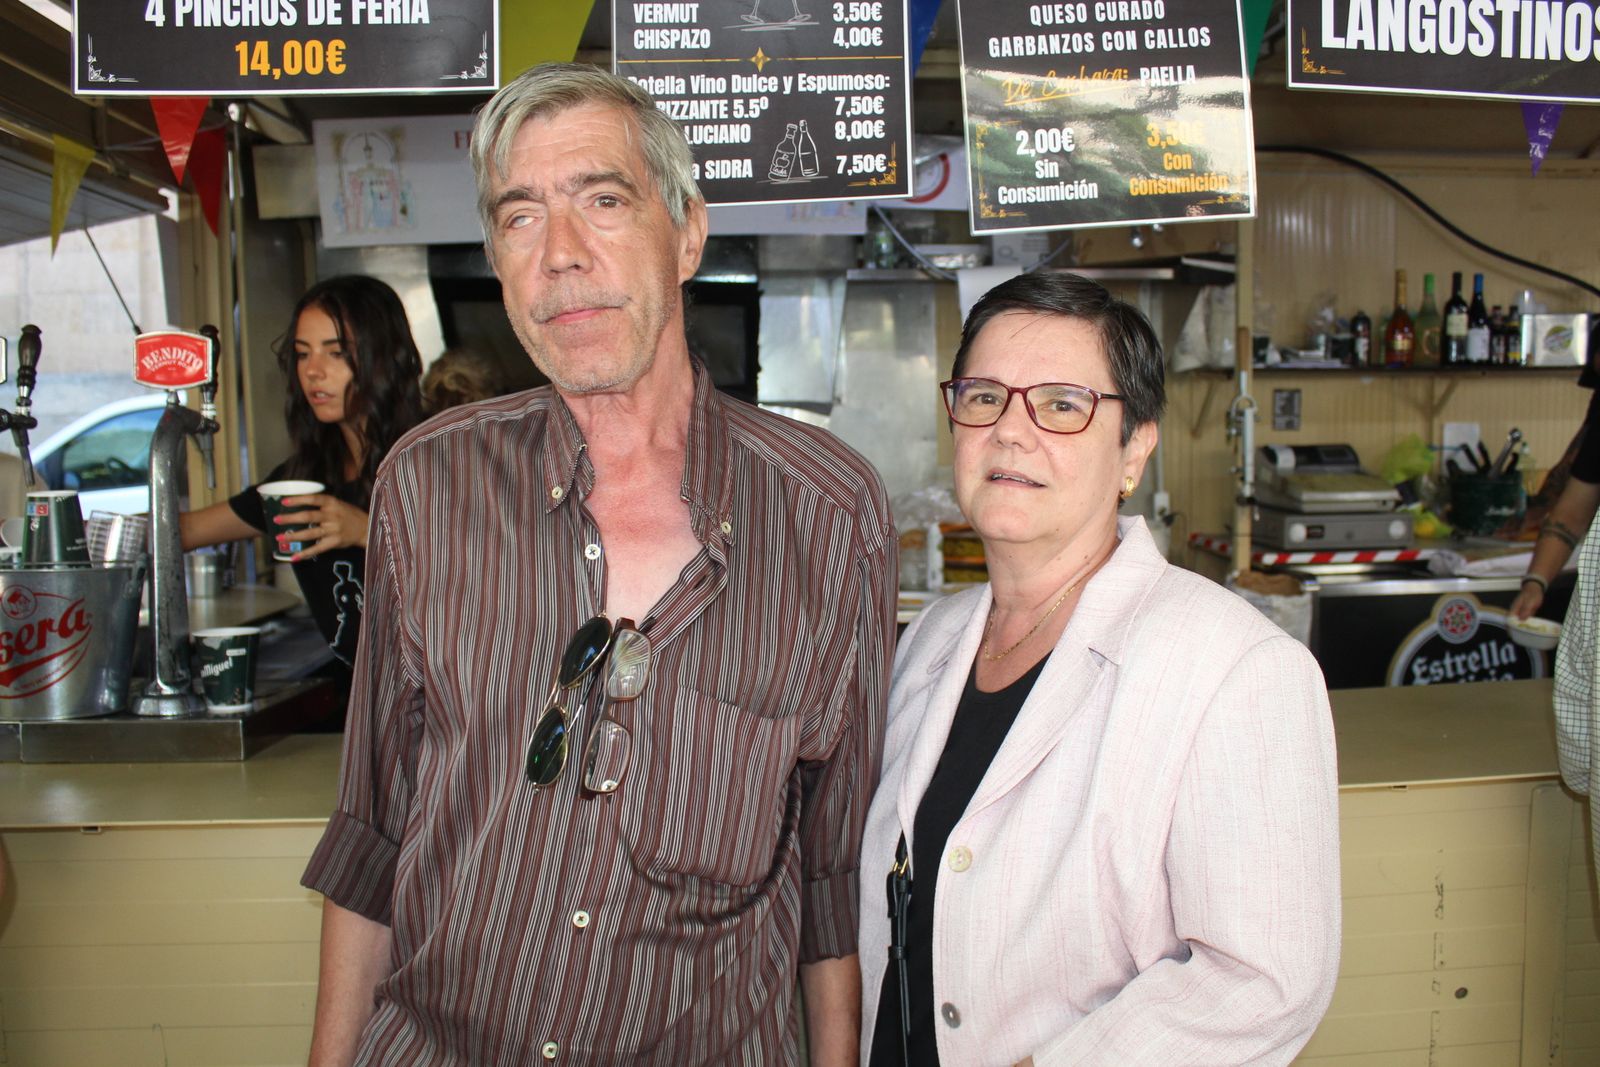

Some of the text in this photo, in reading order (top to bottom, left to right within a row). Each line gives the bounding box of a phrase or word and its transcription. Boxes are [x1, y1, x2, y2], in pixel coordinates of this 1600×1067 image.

[144, 0, 430, 27] 4 PINCHOS DE FERIA
[633, 2, 883, 24] VERMUT 3,50€
[1029, 0, 1166, 27] QUESO CURADO
[633, 27, 883, 50] CHISPAZO 4,00€
[988, 27, 1211, 58] GARBANZOS CON CALLOS
[1321, 0, 1600, 62] LANGOSTINO
[235, 39, 347, 80] 14,00€
[690, 74, 727, 94] Vino
[731, 74, 778, 93] Dulce
[783, 76, 793, 95] y
[797, 72, 890, 95] Espumoso:
[1042, 66, 1129, 96] Chara:
[1139, 65, 1197, 88] PAELLA
[835, 96, 885, 117] 7,50€
[834, 119, 886, 142] 8,00€
[1015, 127, 1075, 156] 2,00€
[704, 159, 753, 180] SIDRA
[835, 154, 887, 176] 7,50€
[1035, 152, 1193, 179] Sin Con
[998, 172, 1230, 205] Consumición Consumición
[140, 346, 204, 372] BENDITO
[1411, 640, 1517, 686] Estrella
